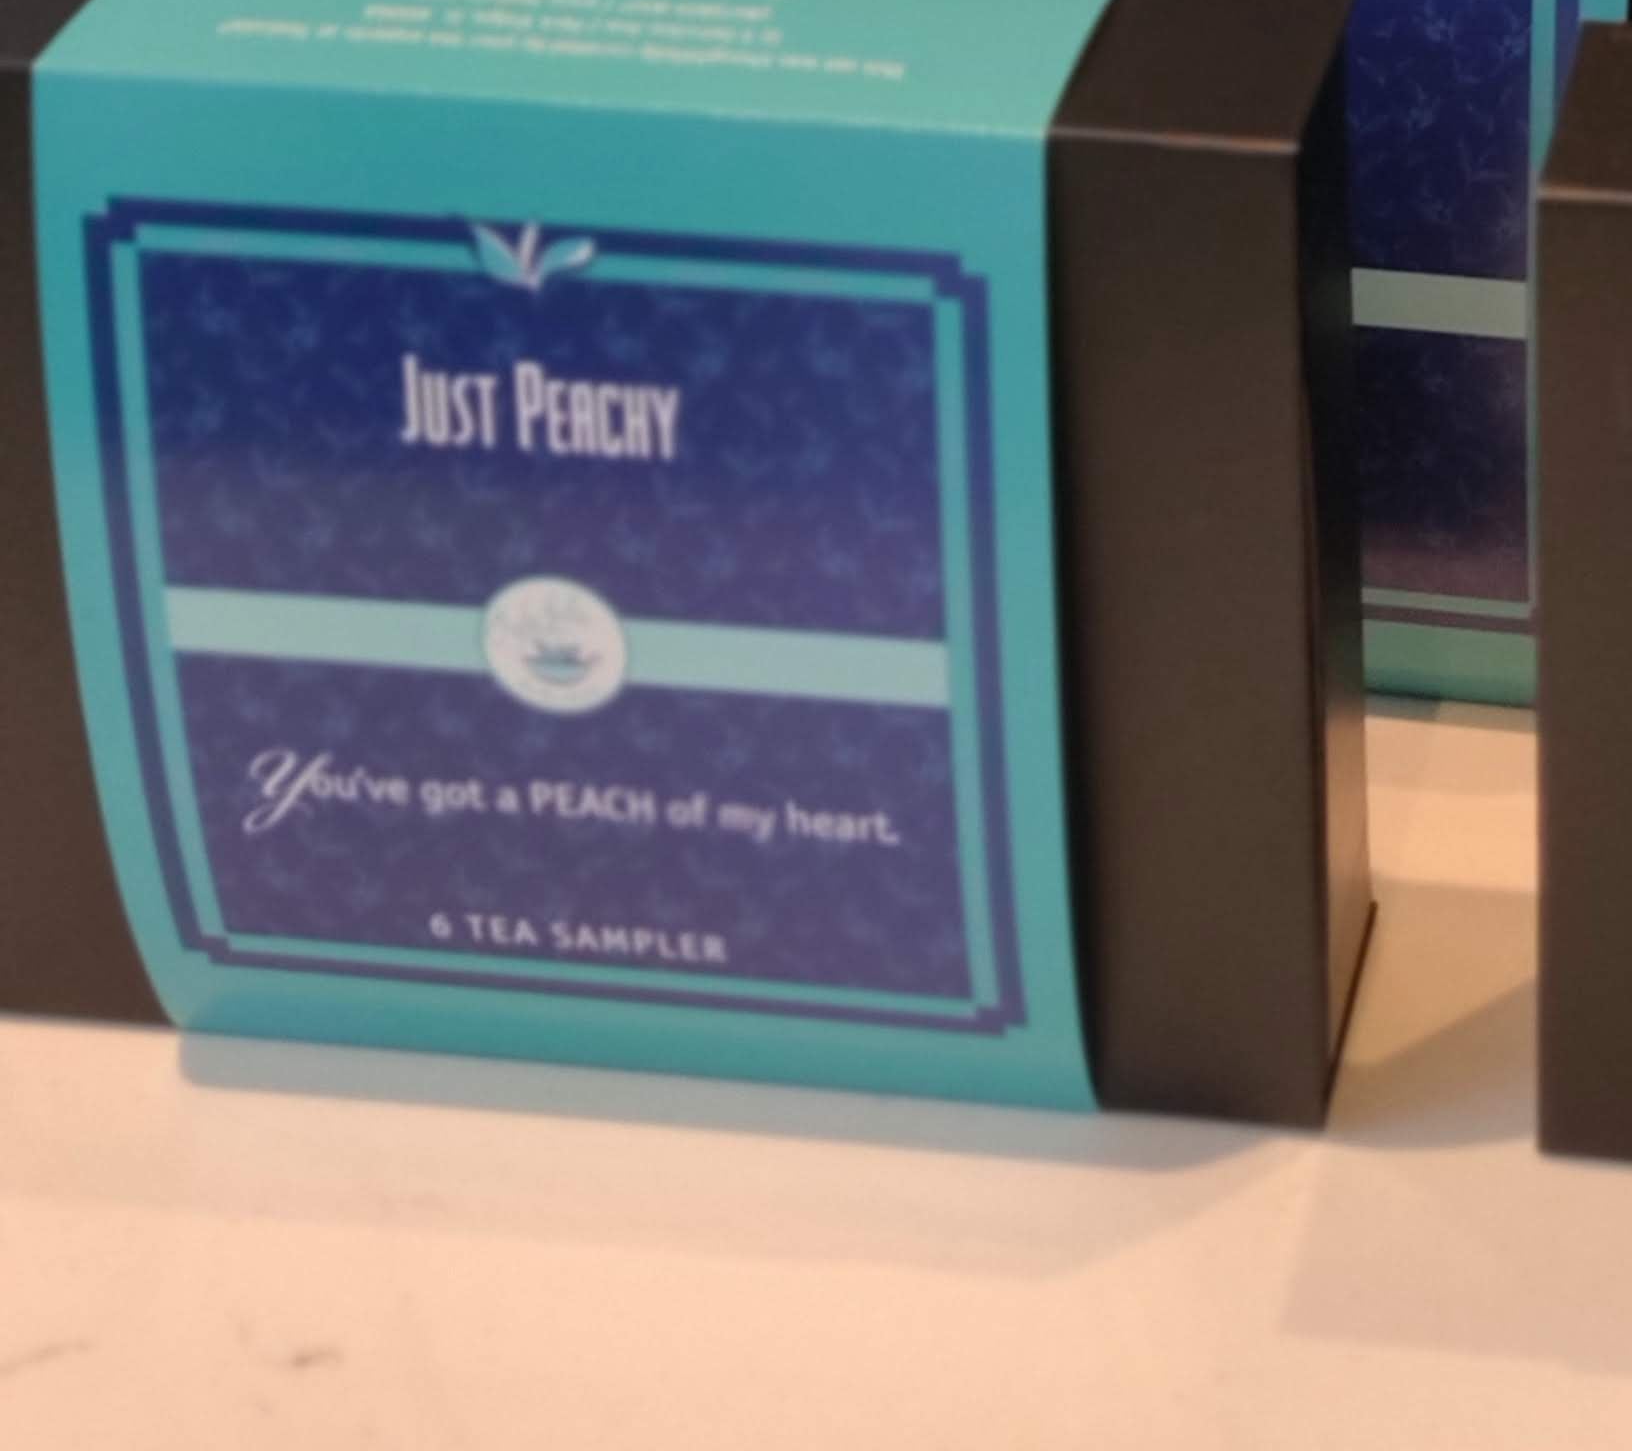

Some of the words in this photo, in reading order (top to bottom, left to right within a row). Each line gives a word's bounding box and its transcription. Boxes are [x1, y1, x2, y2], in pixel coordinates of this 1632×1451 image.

[401, 354, 498, 450] JUST
[515, 361, 682, 462] PEACHY
[243, 747, 408, 835] You've
[420, 774, 487, 817] got
[497, 786, 520, 813] a
[530, 780, 657, 826] PEACH
[667, 797, 710, 828] of
[718, 807, 774, 843] my
[786, 803, 902, 847] heart.
[430, 912, 451, 940] 6
[467, 915, 536, 948] TEA
[551, 921, 728, 964] SAMPLER
